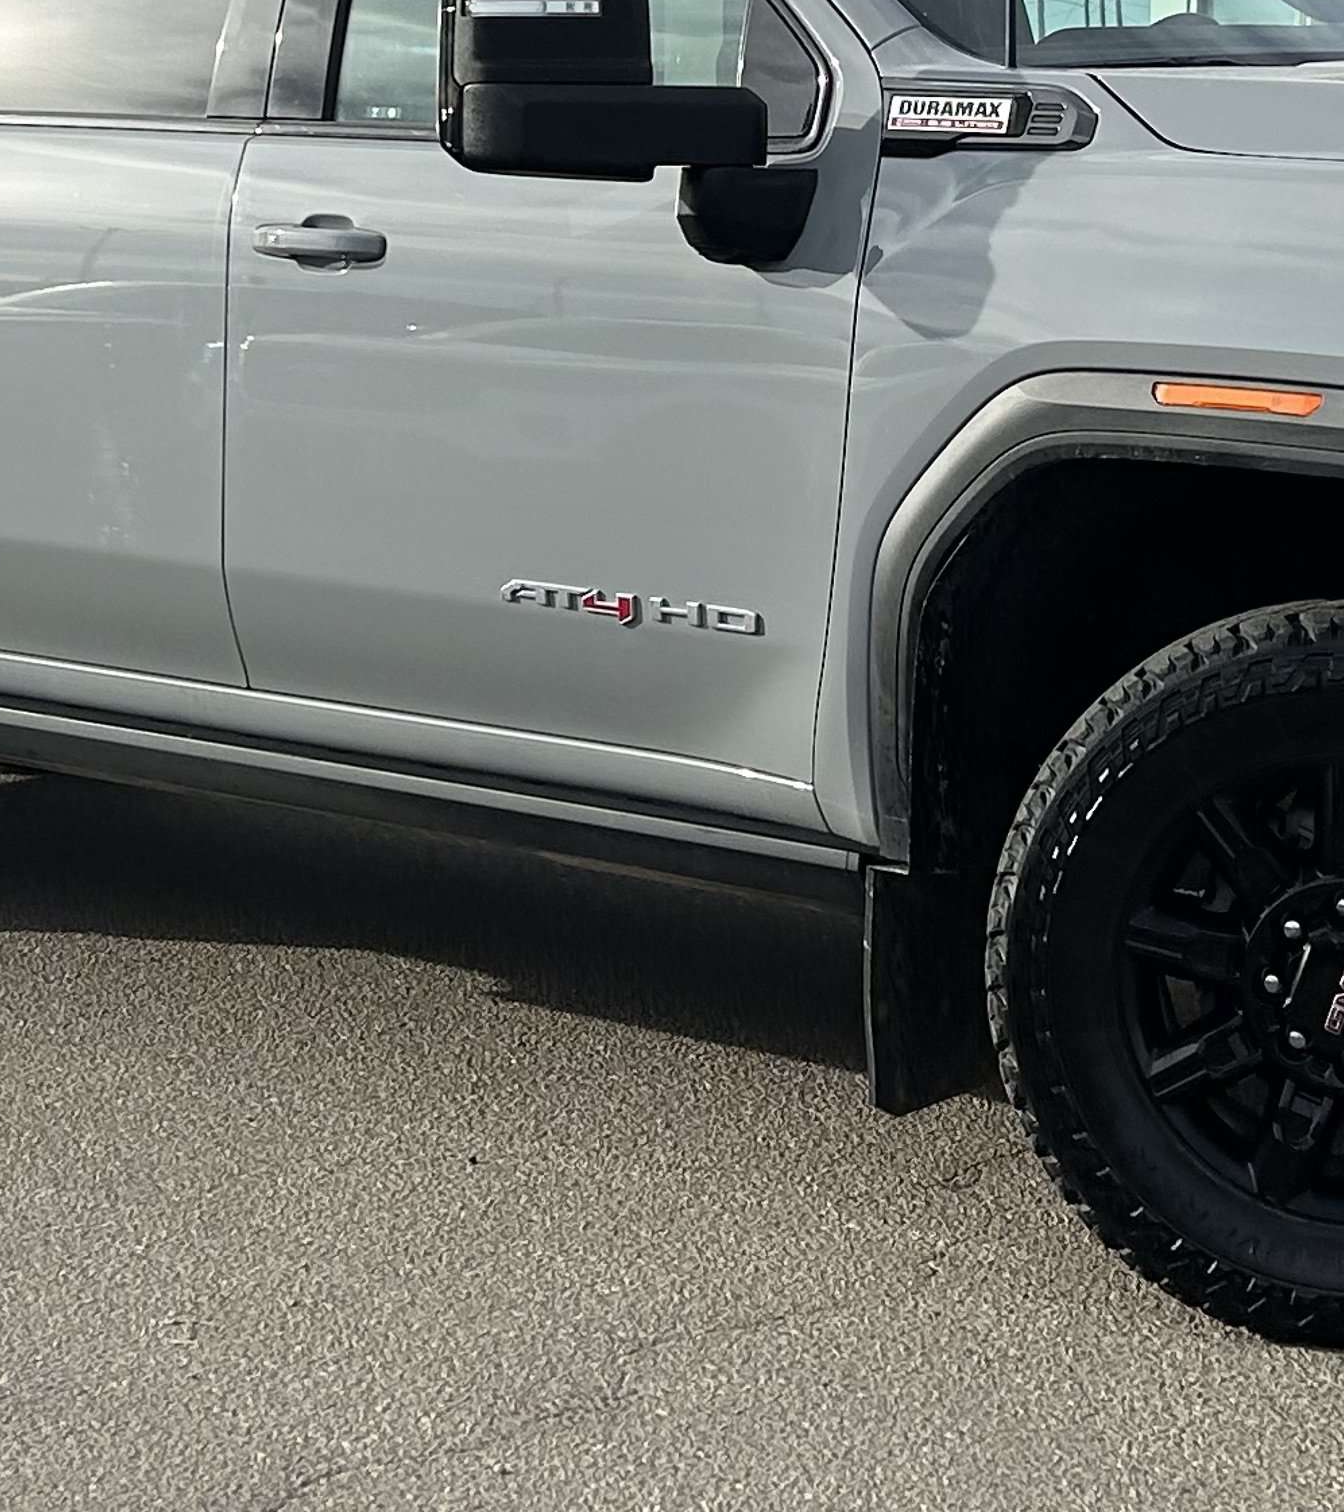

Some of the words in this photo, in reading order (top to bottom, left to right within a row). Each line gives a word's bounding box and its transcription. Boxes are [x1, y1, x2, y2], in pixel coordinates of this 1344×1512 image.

[898, 99, 1003, 118] DURAMAX
[500, 578, 639, 628] AT4
[648, 596, 764, 636] HD
